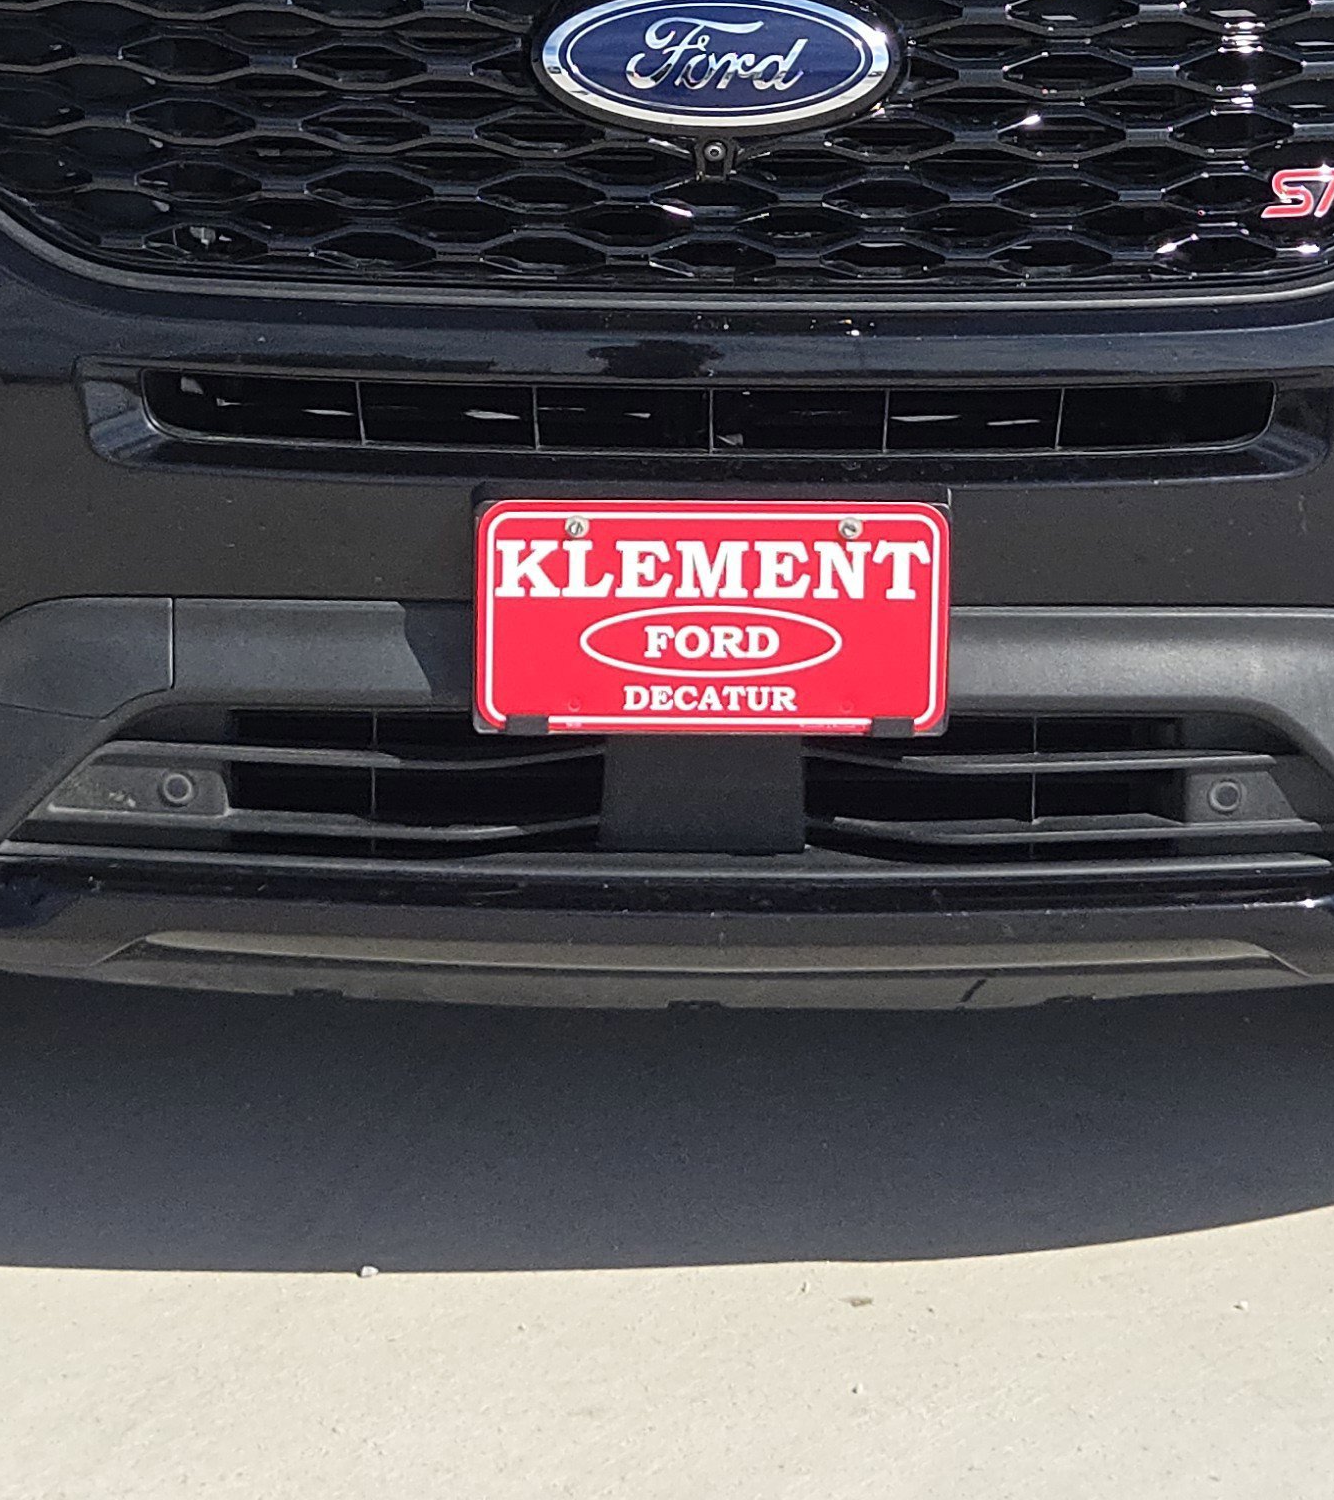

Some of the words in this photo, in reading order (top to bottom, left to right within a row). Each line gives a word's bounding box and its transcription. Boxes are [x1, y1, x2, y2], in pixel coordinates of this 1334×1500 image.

[625, 17, 808, 91] Ford
[495, 539, 930, 600] KLEMENT
[643, 625, 780, 659] FORD
[623, 685, 797, 712] DECATUR
